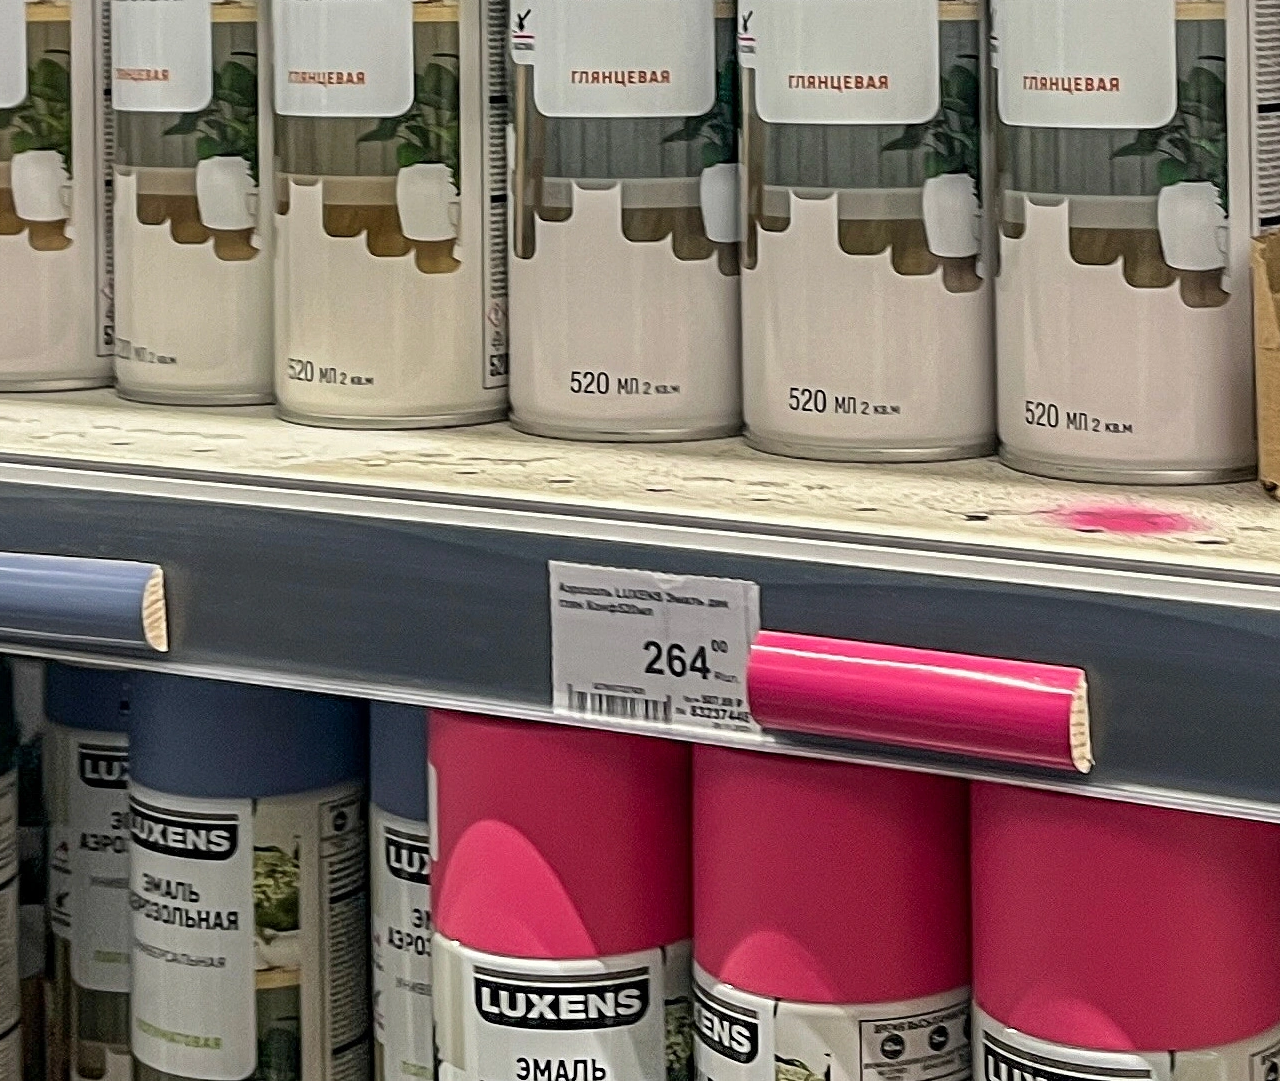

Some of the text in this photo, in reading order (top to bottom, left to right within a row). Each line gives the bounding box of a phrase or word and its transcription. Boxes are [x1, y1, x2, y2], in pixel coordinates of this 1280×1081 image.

[571, 70, 671, 87] ГЛЯНЦЕВАЯ
[788, 75, 890, 92] ГЛЯНЦЕВАЯ
[1023, 75, 1121, 95] ГЛЯНЦЕВАЯ
[570, 371, 610, 394] 520
[617, 377, 639, 394] МЛ
[787, 387, 827, 413] 520
[834, 394, 857, 415] МЛ
[1025, 400, 1059, 428] 520
[1066, 411, 1088, 431] МЛ
[1091, 418, 1101, 432] 2
[643, 640, 712, 680] 264
[481, 986, 643, 1021] LUXENS
